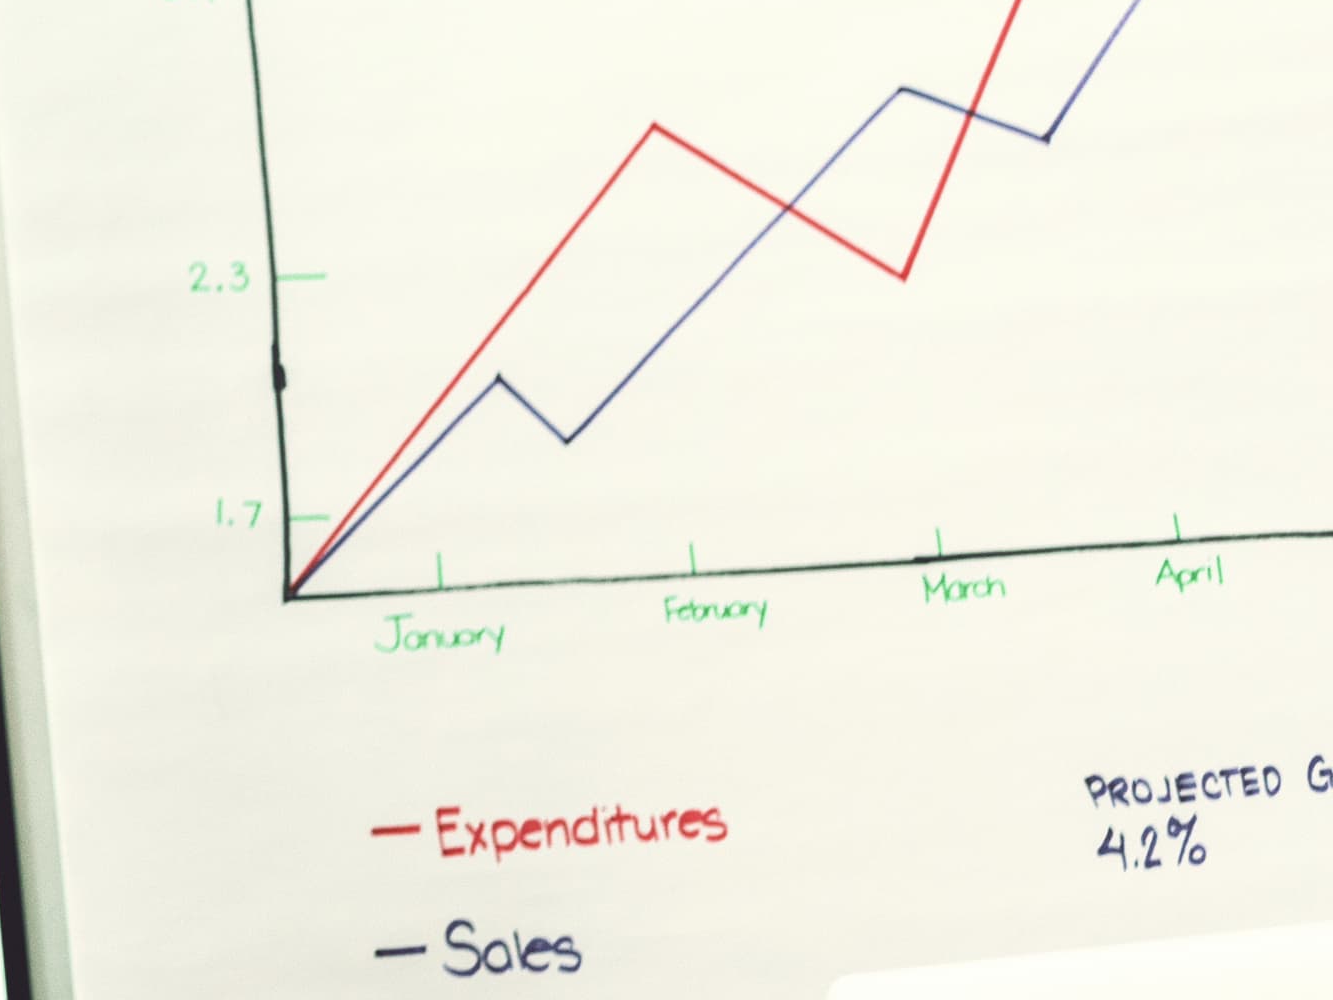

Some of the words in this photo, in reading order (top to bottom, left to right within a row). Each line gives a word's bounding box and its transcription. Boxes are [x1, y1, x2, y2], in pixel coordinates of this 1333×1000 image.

[190, 262, 250, 292] 2.3
[217, 498, 261, 528] 1.7
[923, 573, 1007, 604] March
[1156, 555, 1224, 592] April
[664, 596, 768, 629] February
[374, 614, 505, 654] January
[1085, 765, 1282, 808] PROJECTED
[436, 804, 728, 862] Expenditures
[1096, 813, 1207, 872] 4.2%
[443, 919, 582, 977] Sales
